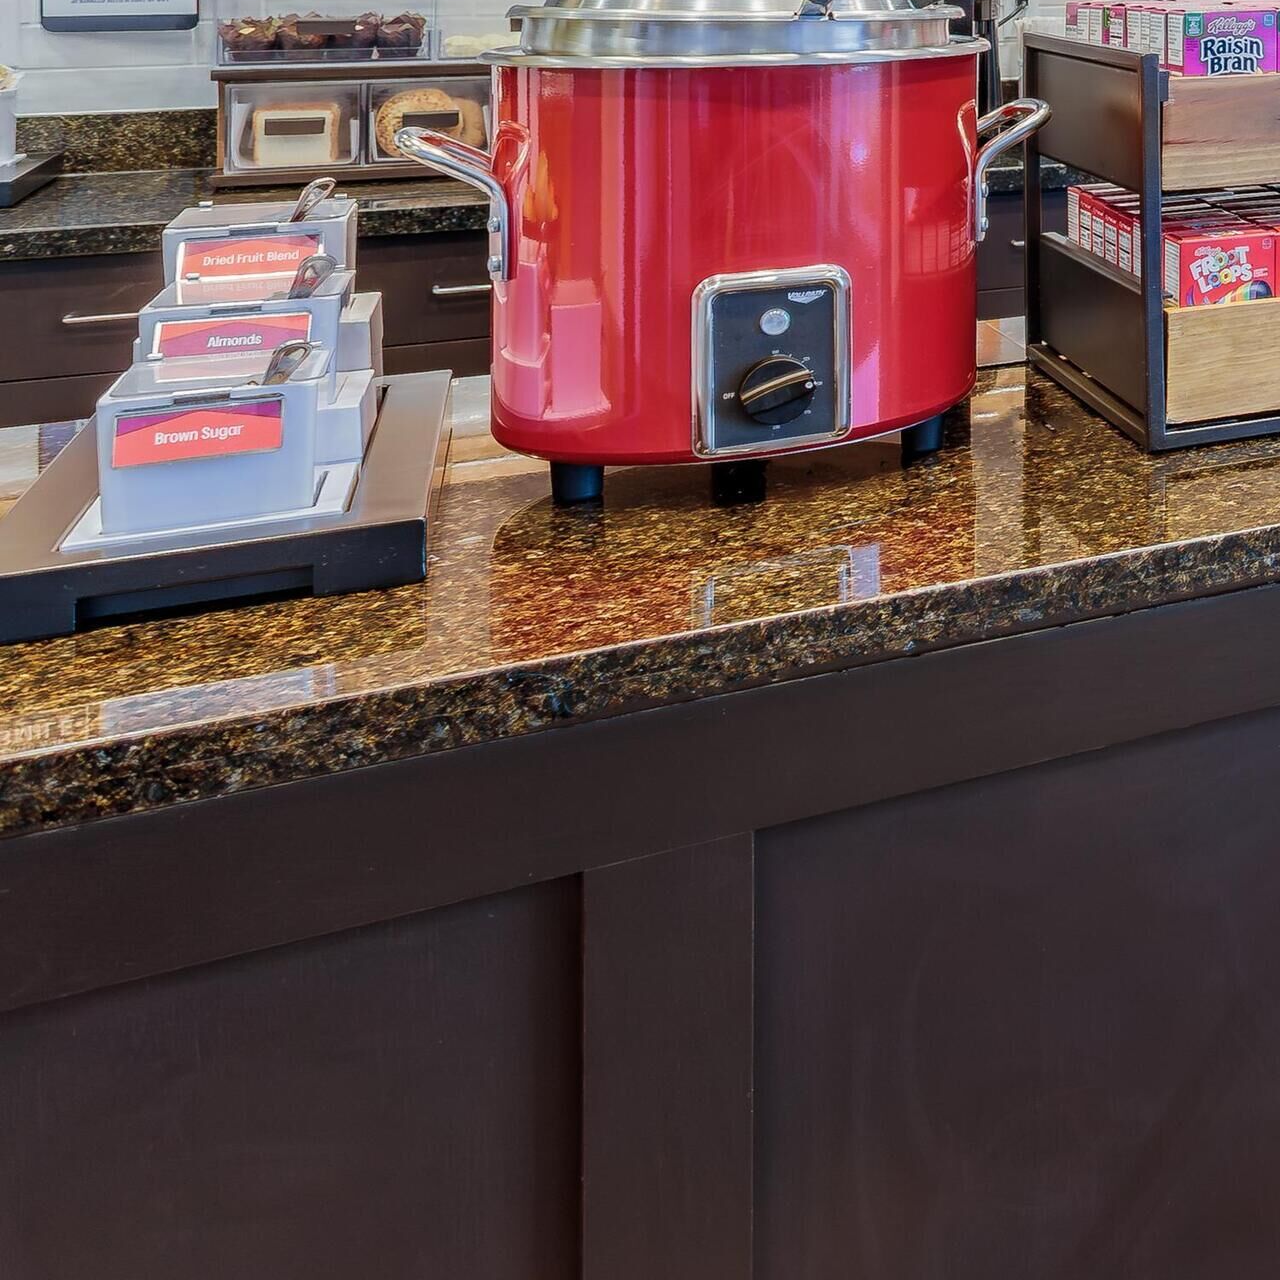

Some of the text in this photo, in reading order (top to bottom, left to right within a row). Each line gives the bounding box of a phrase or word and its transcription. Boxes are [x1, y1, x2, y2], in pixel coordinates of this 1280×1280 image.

[1207, 17, 1256, 35] Kellogg's
[1201, 36, 1264, 60] Raisin
[1209, 55, 1257, 76] Bran
[203, 249, 300, 267] Dried Fruit Blend
[1189, 246, 1250, 280] FROOT
[1197, 263, 1253, 293] LOOPS
[206, 333, 262, 349] Almonds
[722, 392, 736, 400] OFF
[154, 423, 244, 446] Brown Sugar
